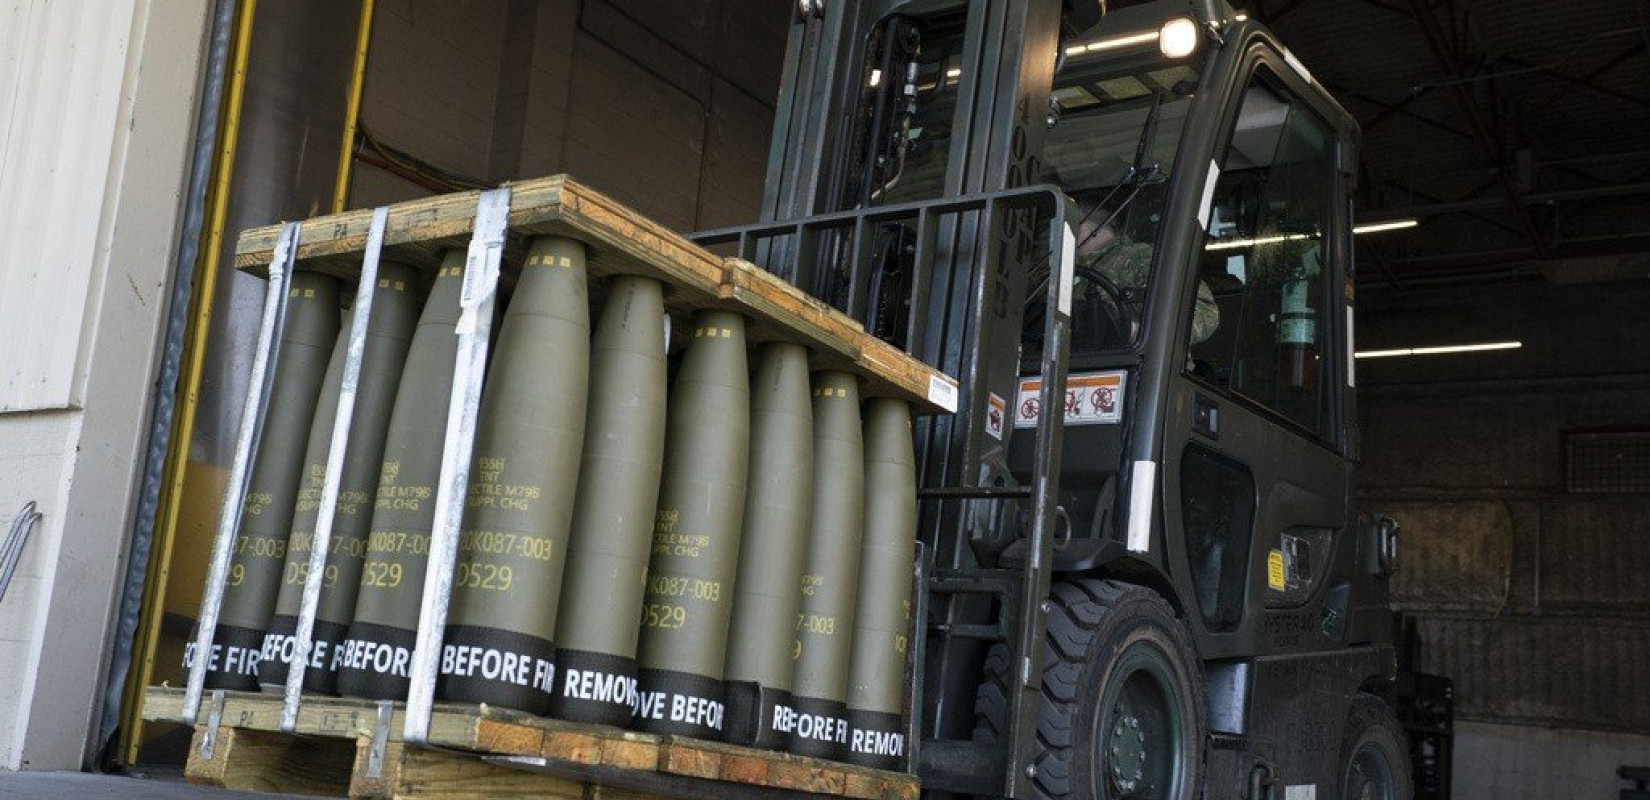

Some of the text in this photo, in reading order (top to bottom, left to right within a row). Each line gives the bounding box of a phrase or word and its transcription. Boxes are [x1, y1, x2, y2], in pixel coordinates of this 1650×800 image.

[500, 497, 528, 511] CHG
[675, 546, 699, 557] CHG
[441, 645, 532, 685] BEFORE
